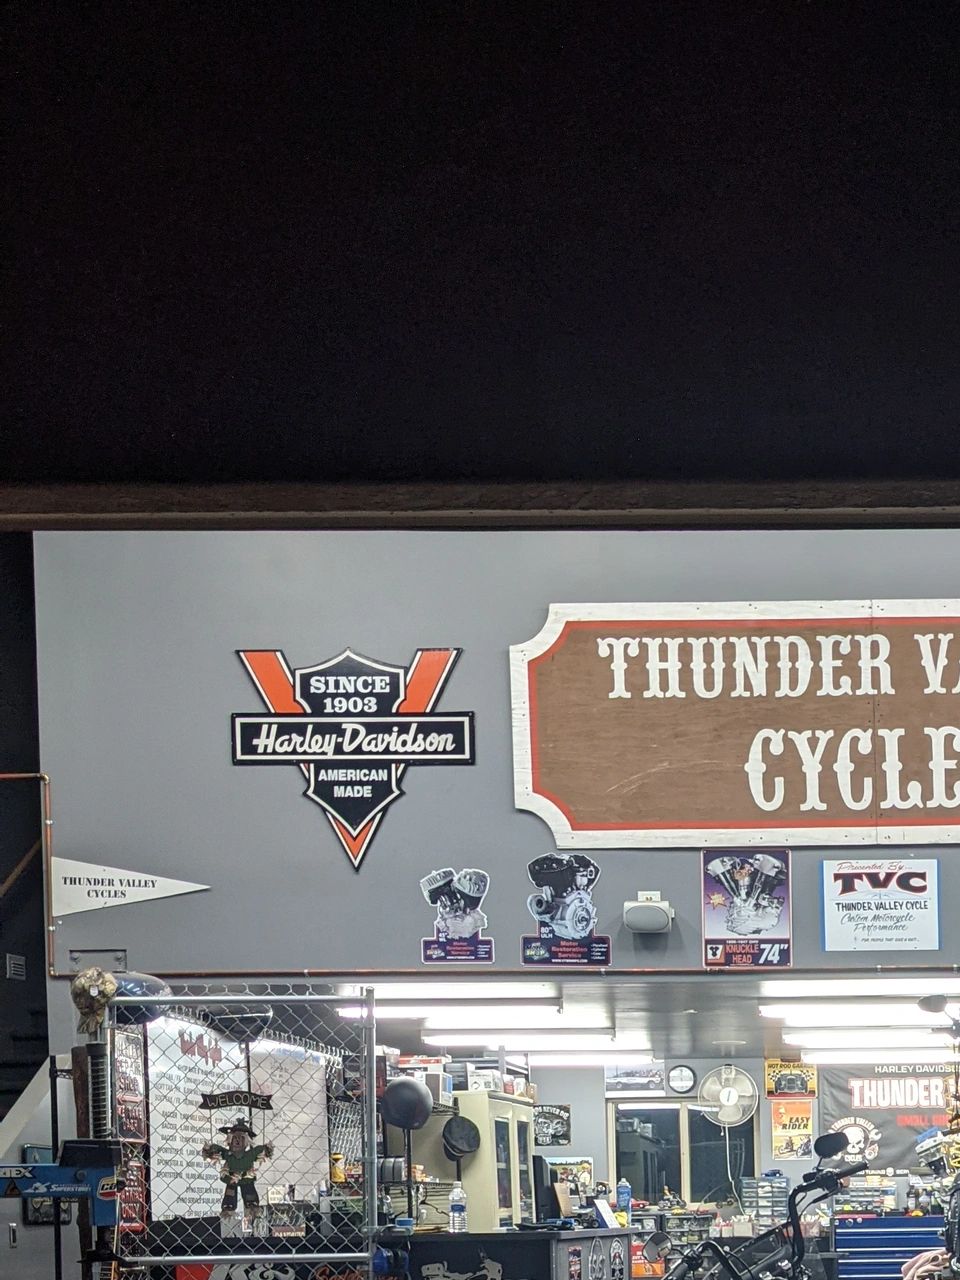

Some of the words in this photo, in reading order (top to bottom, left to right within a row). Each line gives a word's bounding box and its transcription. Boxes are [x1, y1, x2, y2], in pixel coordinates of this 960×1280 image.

[596, 632, 895, 700] THUNDER
[309, 676, 391, 694] SINCE
[323, 696, 378, 713] 1903
[252, 722, 456, 757] Harley-Davidson
[318, 769, 388, 781] AMERICAN
[333, 785, 373, 798] MADE
[62, 876, 115, 887] THUNDER
[118, 878, 157, 888] VALLEY
[833, 871, 928, 896] TVC
[87, 889, 126, 898] CYCLES
[835, 902, 874, 912] THUNDER
[874, 901, 904, 911] VALLEY
[905, 900, 929, 910] CYCLE
[853, 923, 908, 937] Performance
[726, 944, 759, 953] KNUCKLE
[732, 954, 752, 963] HEAD
[874, 1065, 913, 1073] HARLEY
[849, 1077, 945, 1108] THUNDER
[206, 1093, 267, 1108] WELCOME
